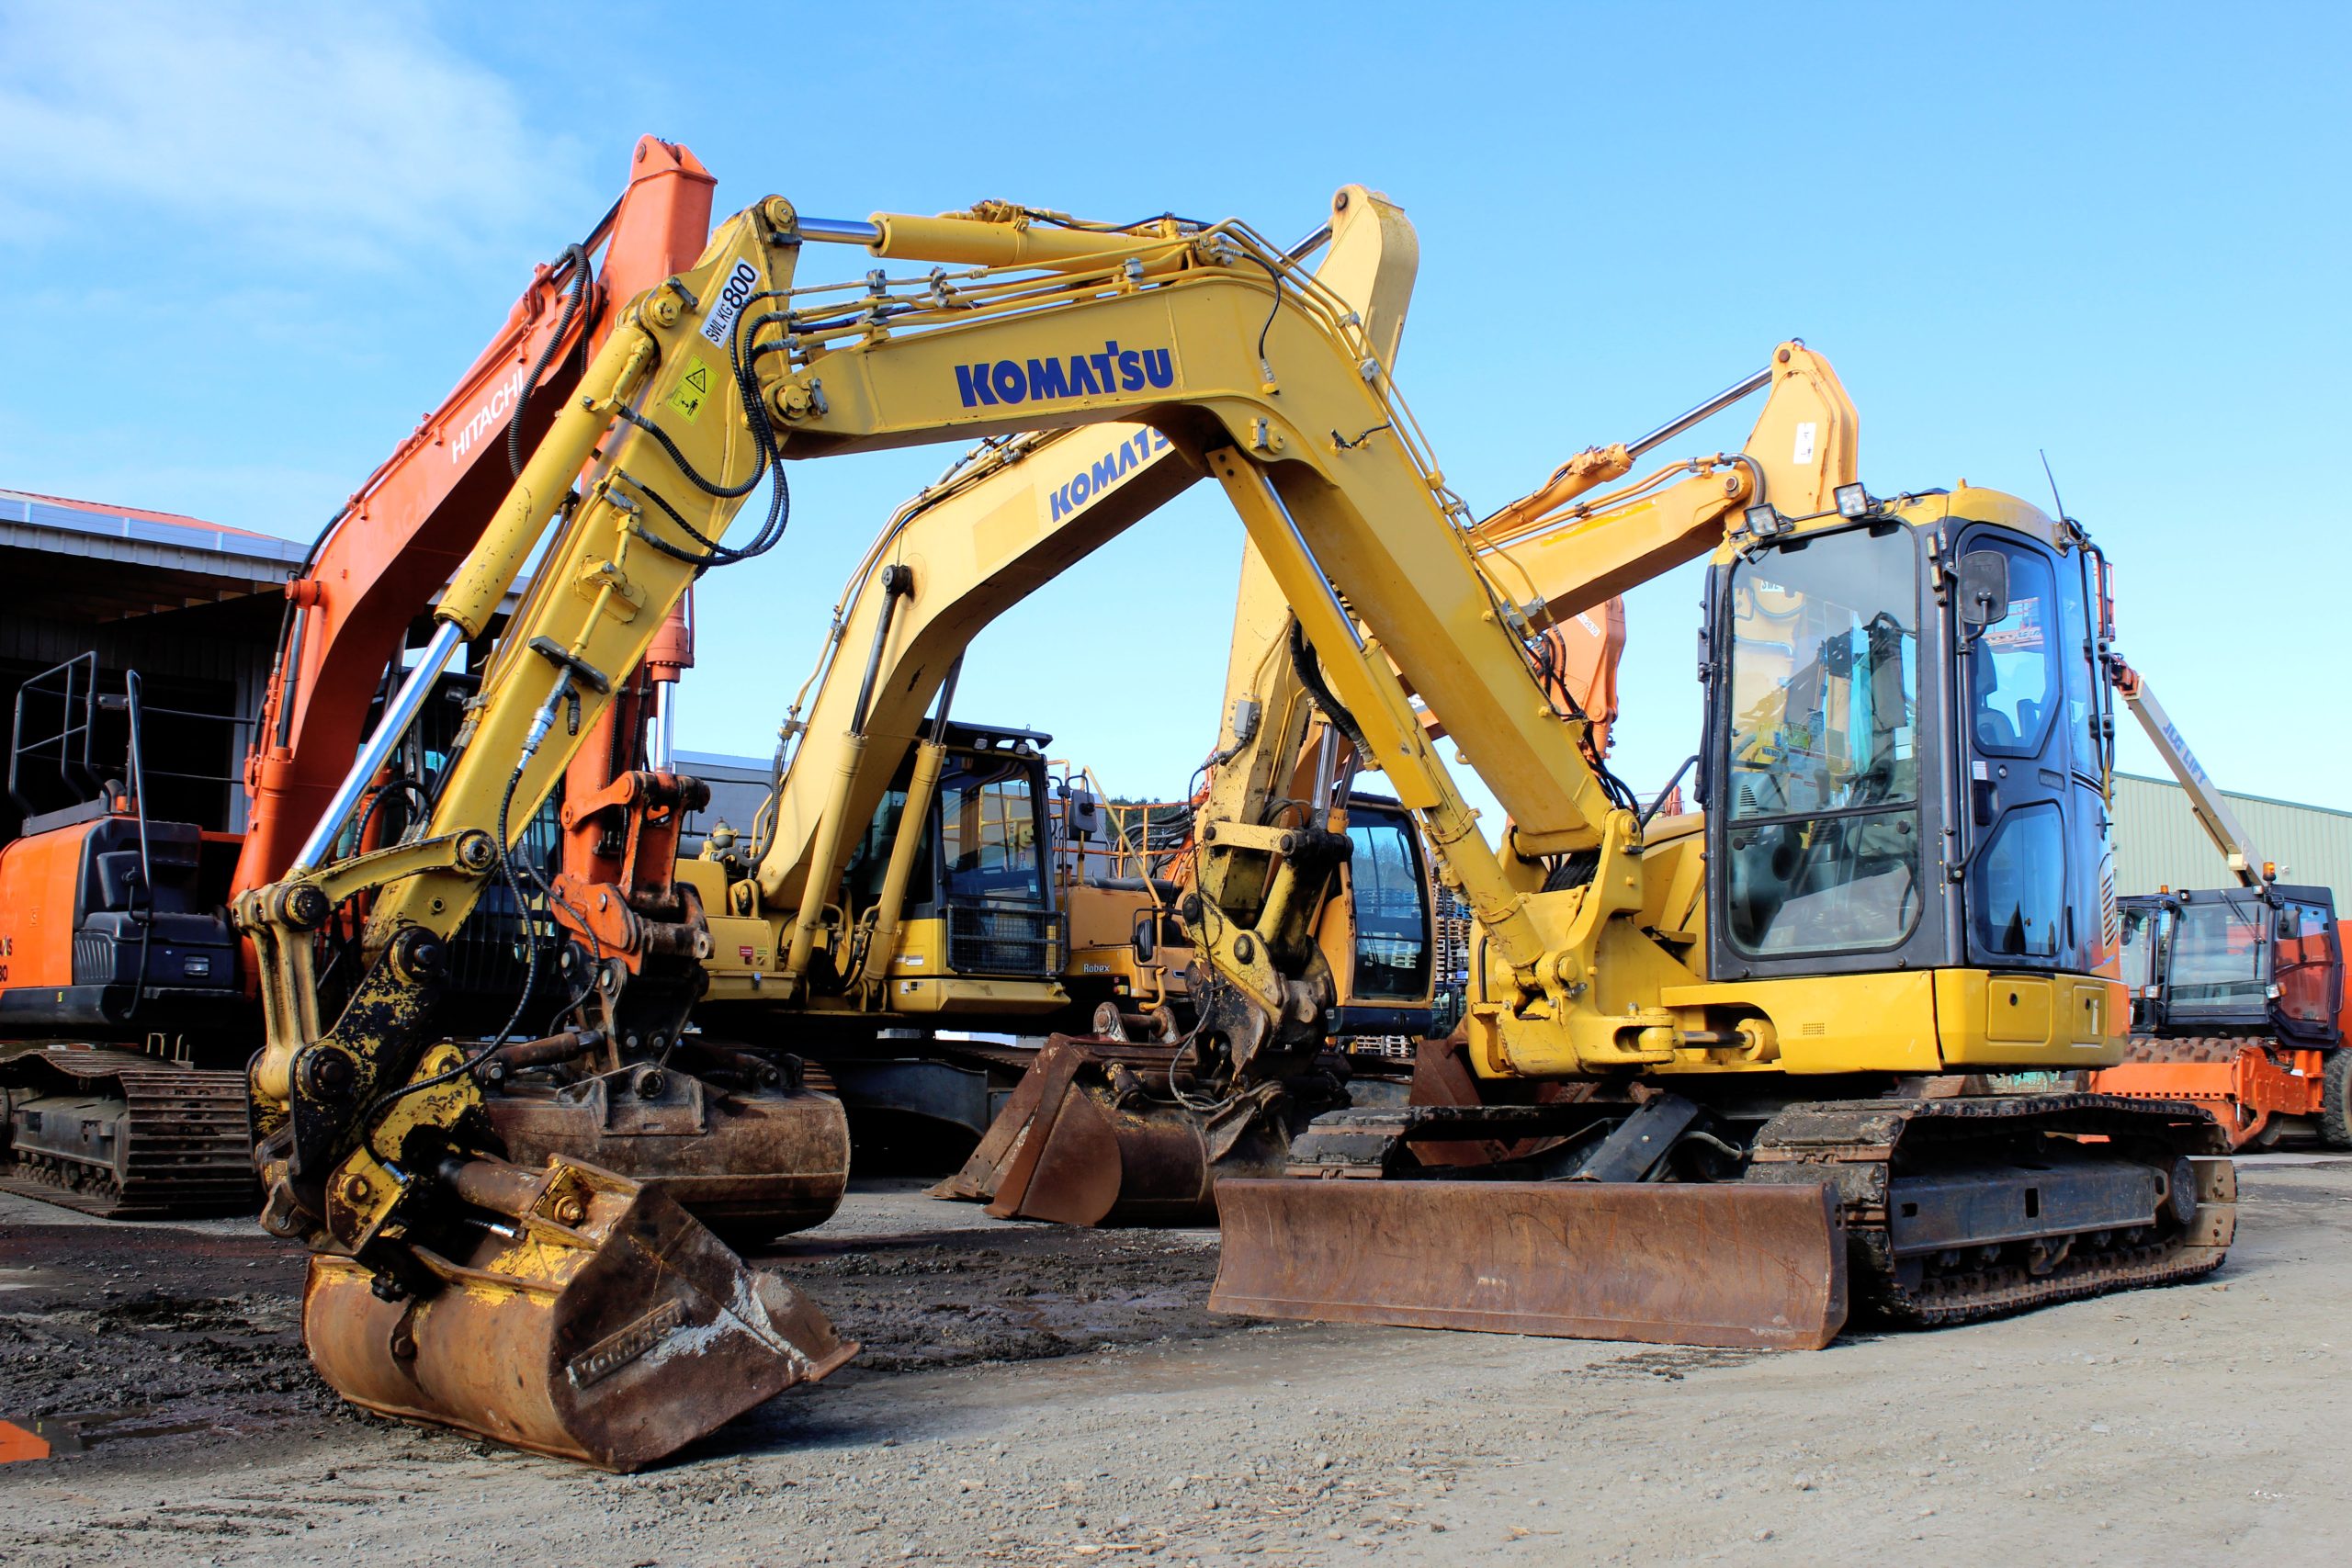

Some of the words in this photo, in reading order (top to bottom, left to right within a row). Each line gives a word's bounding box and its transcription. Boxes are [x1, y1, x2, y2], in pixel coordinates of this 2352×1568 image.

[722, 264, 756, 309] 800
[706, 320, 726, 343] SWL
[717, 303, 733, 322] KG
[955, 341, 1174, 408] KOMATSU
[452, 367, 524, 464] HITACHI
[1050, 425, 1170, 524] KOMATS
[1083, 964, 1110, 973] Robex
